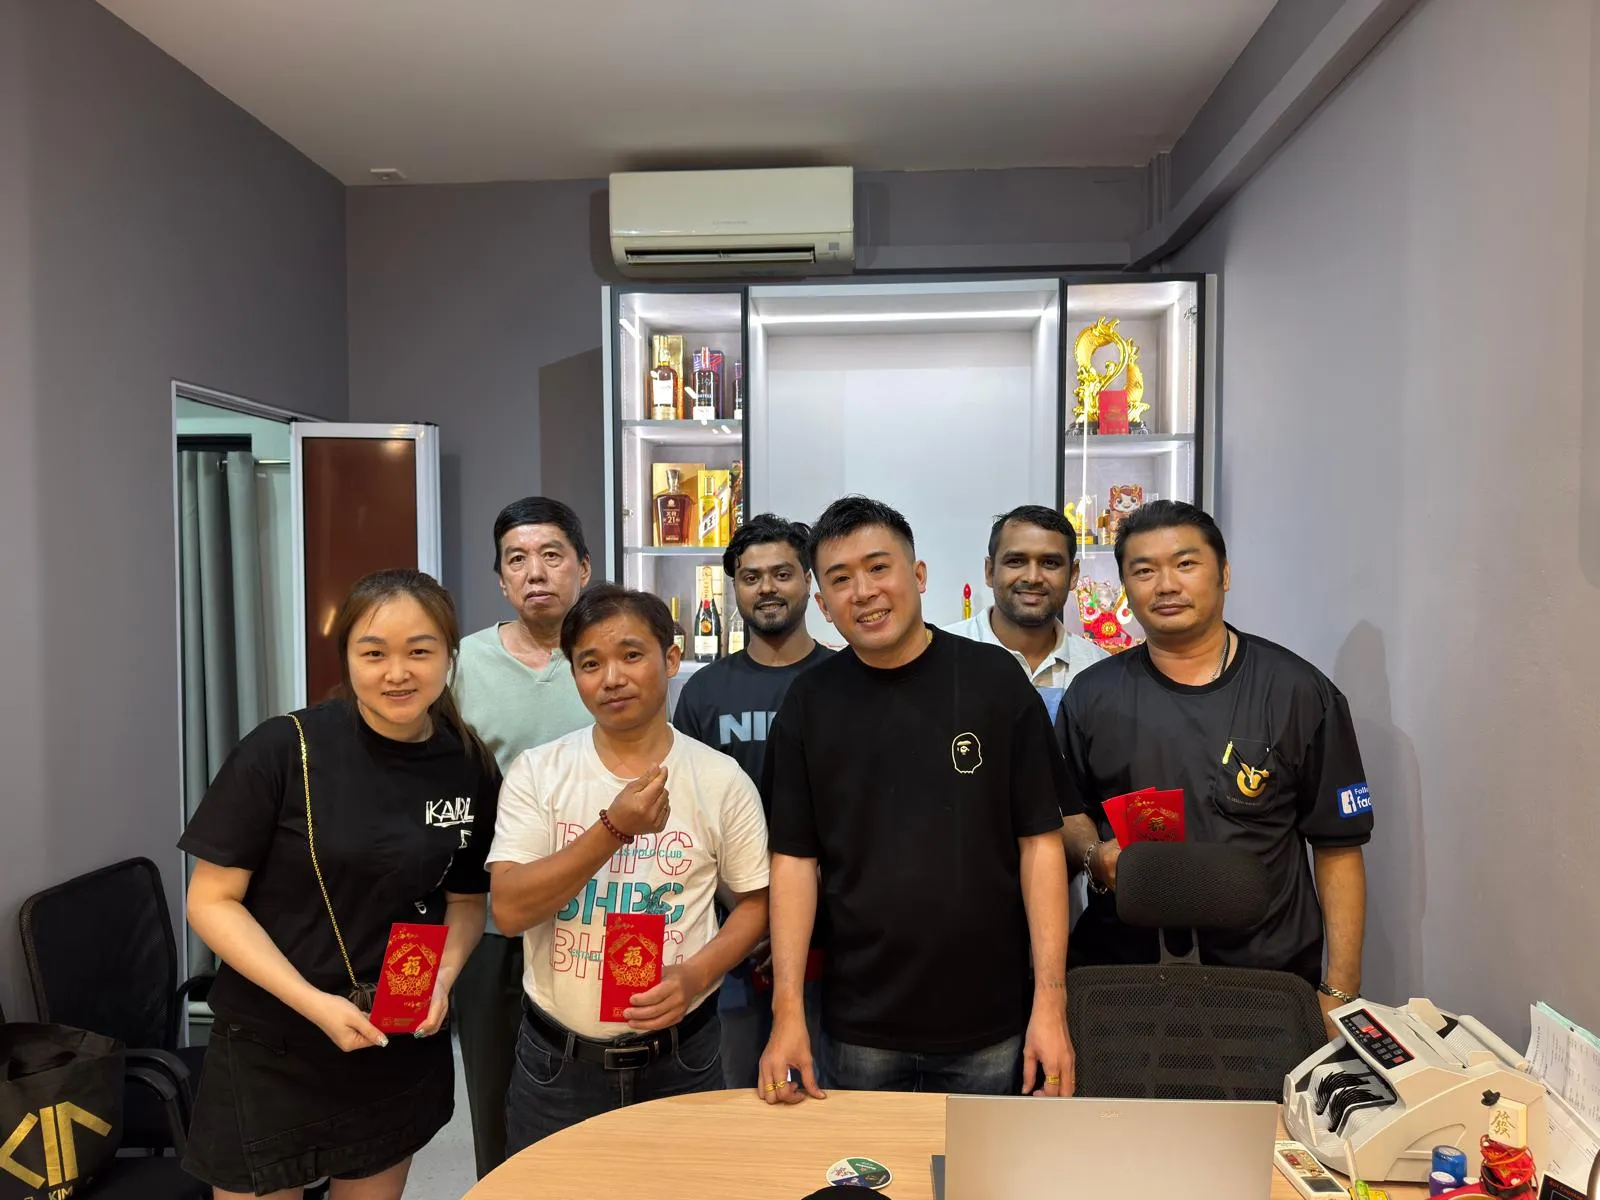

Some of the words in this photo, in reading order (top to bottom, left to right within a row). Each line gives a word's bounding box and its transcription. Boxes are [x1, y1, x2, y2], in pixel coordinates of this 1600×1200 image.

[425, 797, 475, 825] KARL
[658, 849, 682, 859] CLUB
[401, 956, 422, 976] 福
[623, 946, 643, 968] 福
[1490, 1110, 1516, 1139] 發
[48, 1186, 73, 1200] KIM
